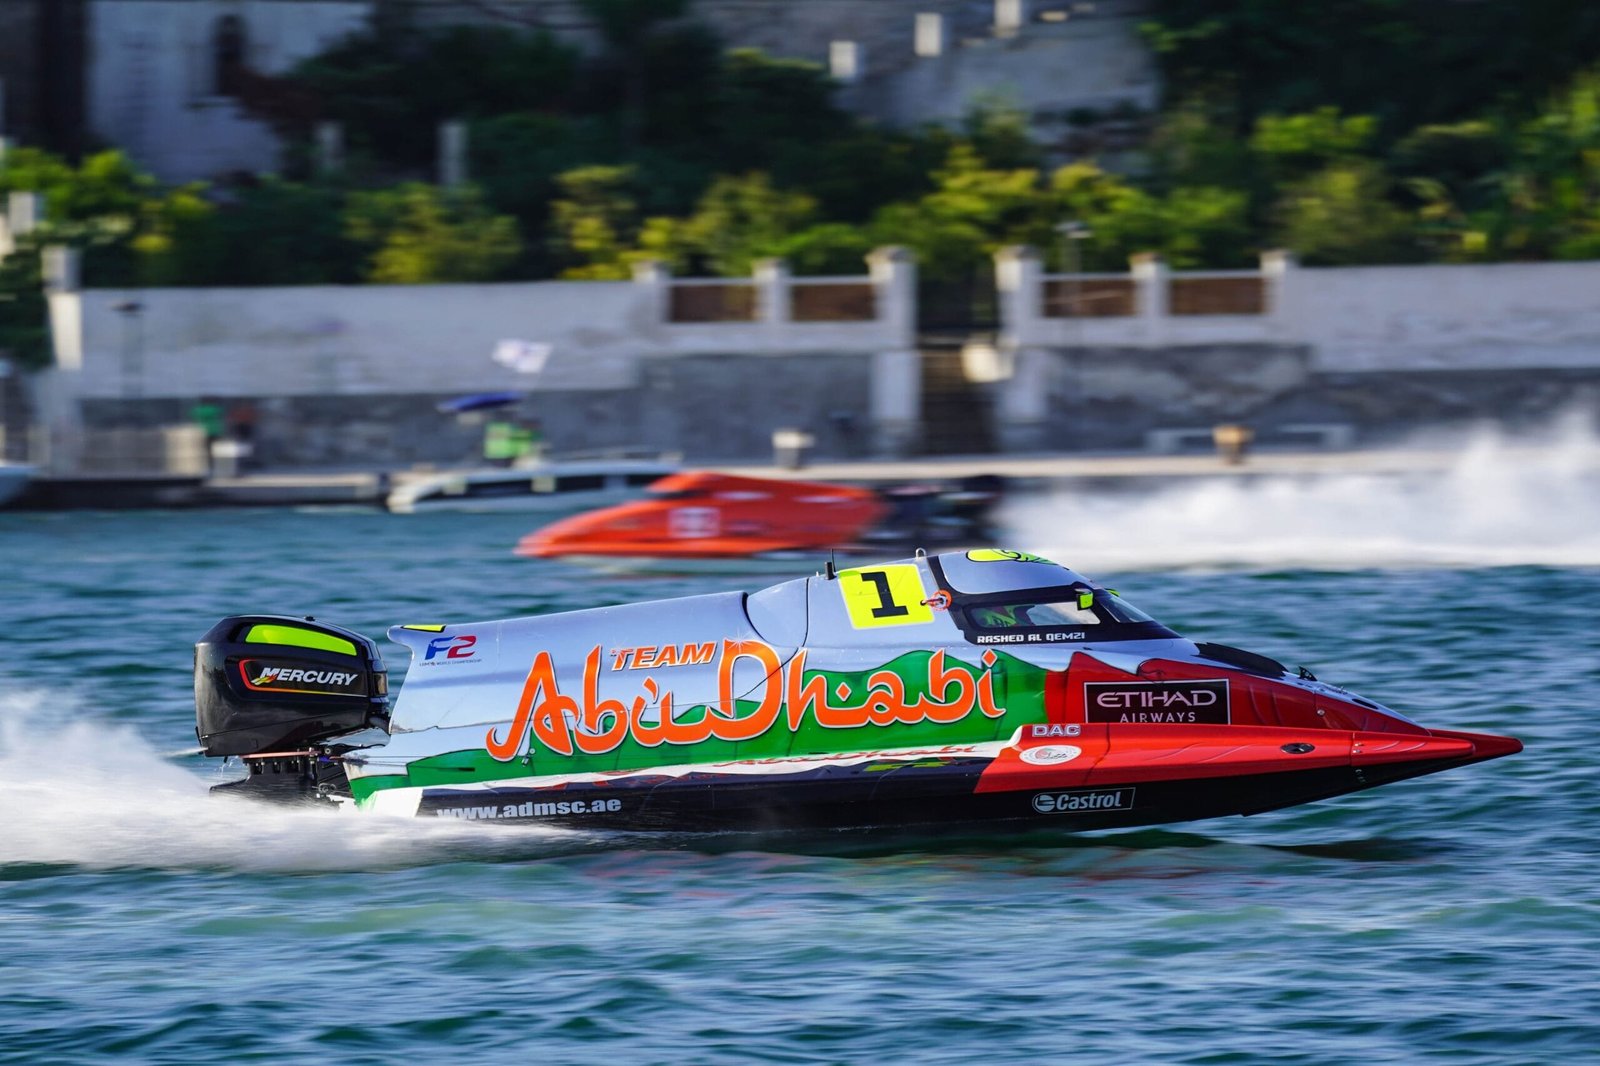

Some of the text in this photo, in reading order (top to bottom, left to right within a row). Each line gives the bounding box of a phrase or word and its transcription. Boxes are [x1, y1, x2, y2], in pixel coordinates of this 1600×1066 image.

[861, 571, 909, 619] 1
[424, 635, 477, 661] F2
[977, 634, 1024, 644] RASHED
[1028, 633, 1042, 642] AL
[610, 641, 718, 671] TEAM
[259, 667, 359, 686] MERCURY
[1096, 689, 1217, 708] ETIHAD
[1120, 711, 1197, 724] AIRWAYS
[435, 799, 622, 820] www.admsc.ae
[1056, 791, 1122, 811] Castrol
